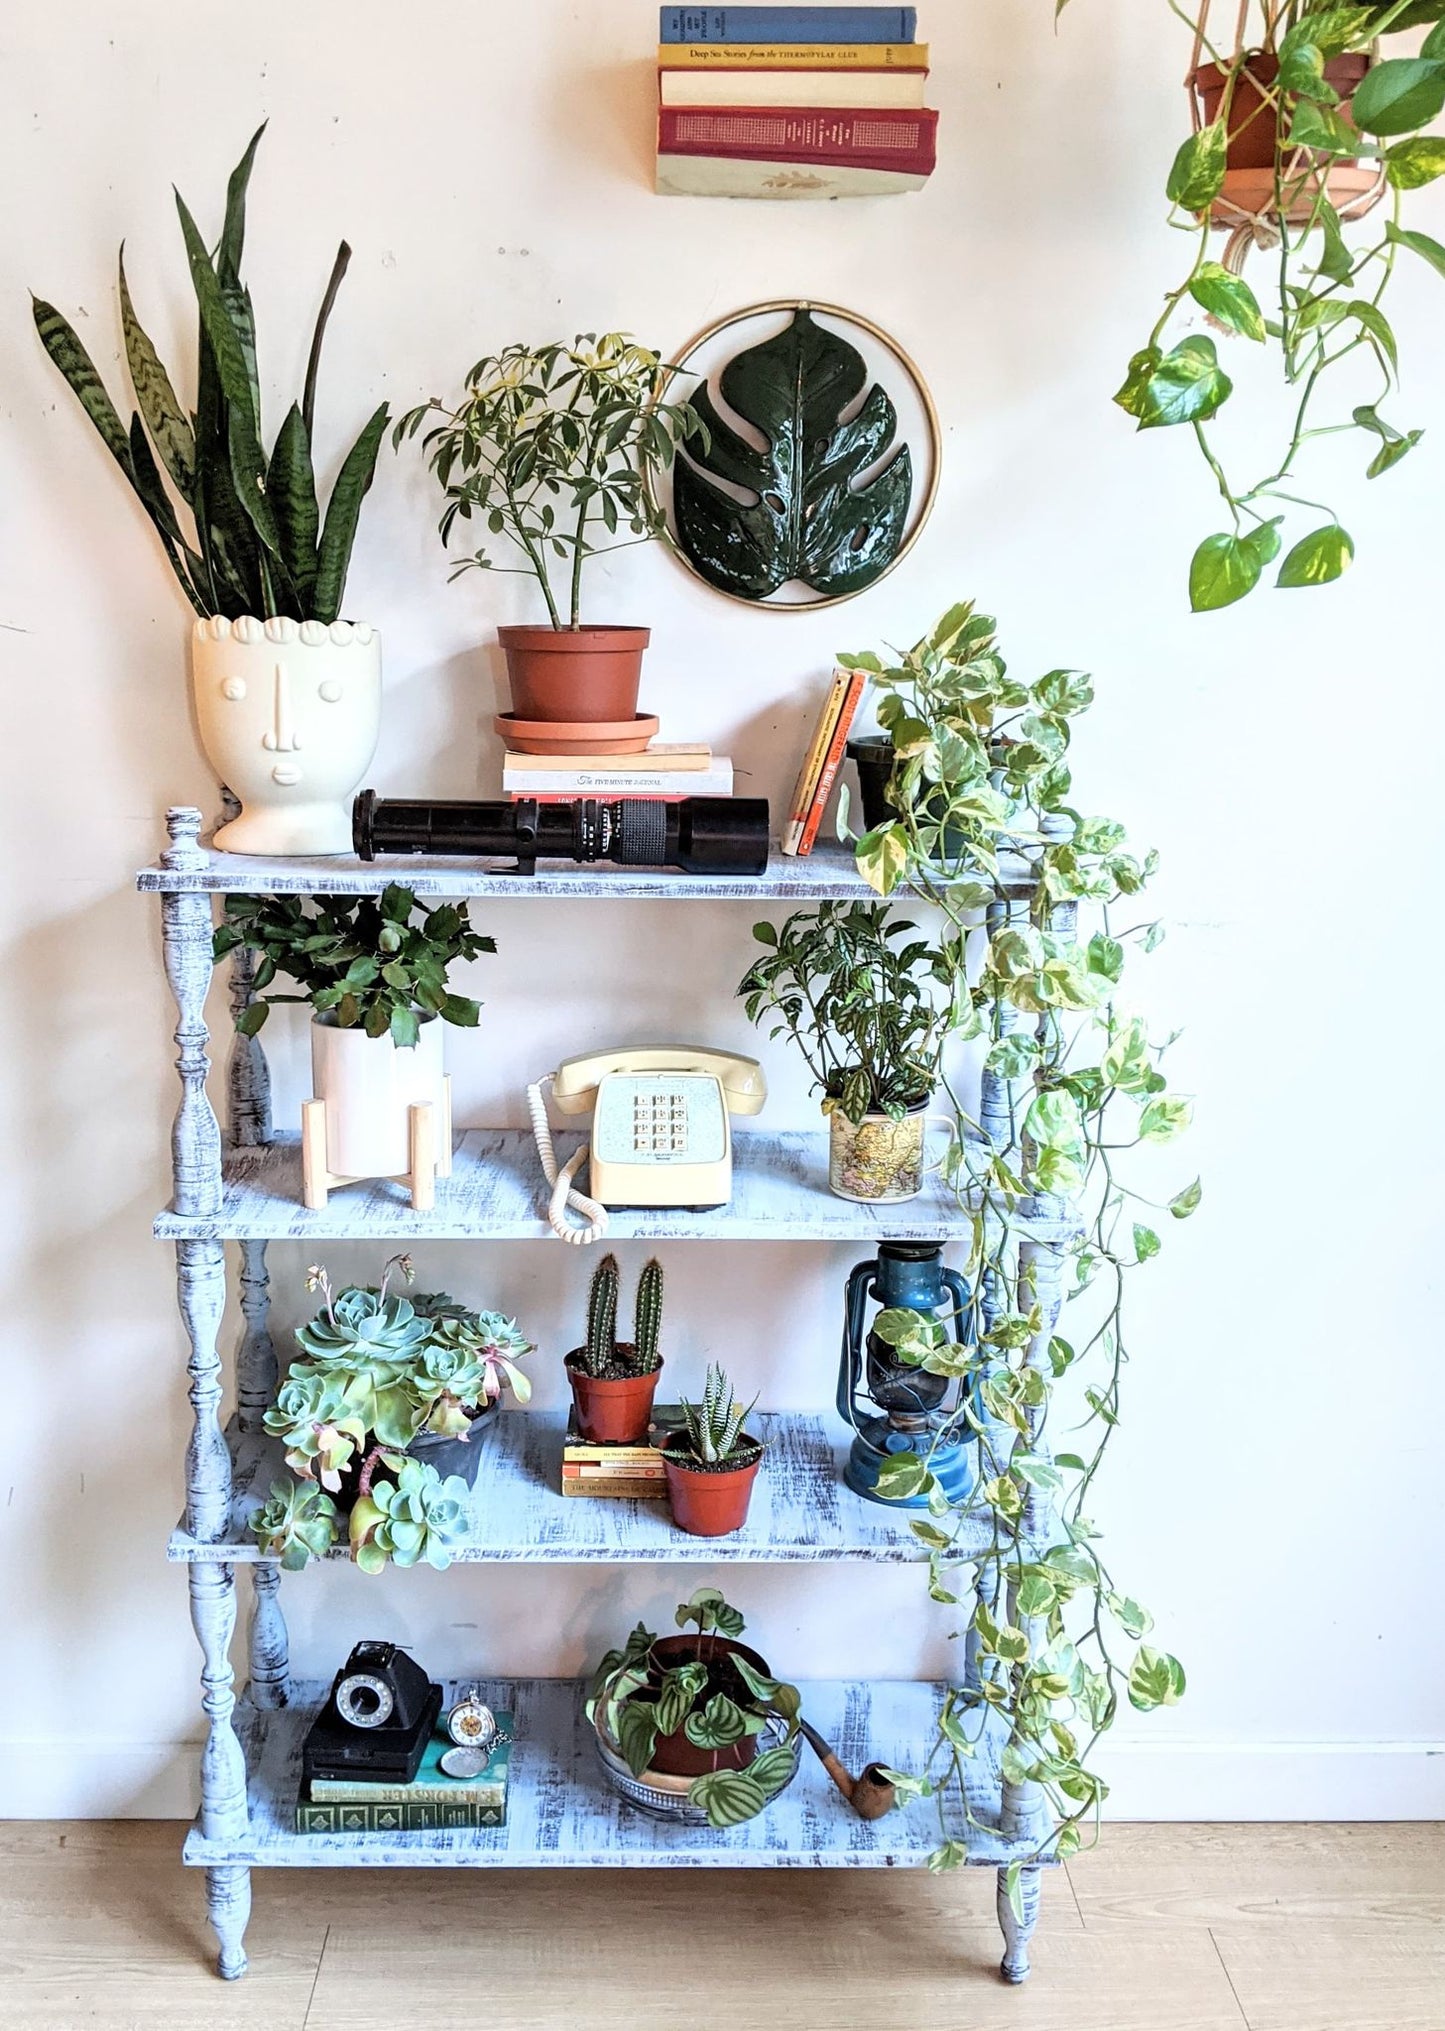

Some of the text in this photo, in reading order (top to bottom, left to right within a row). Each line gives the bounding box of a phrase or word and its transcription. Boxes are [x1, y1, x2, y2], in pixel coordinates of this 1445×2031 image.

[690, 49, 708, 59] Deep
[710, 50, 721, 58] Sea
[723, 50, 746, 58] Stories
[747, 49, 765, 60] from
[767, 50, 777, 58] the
[577, 775, 592, 785] The
[382, 1789, 458, 1802] FORSTER
